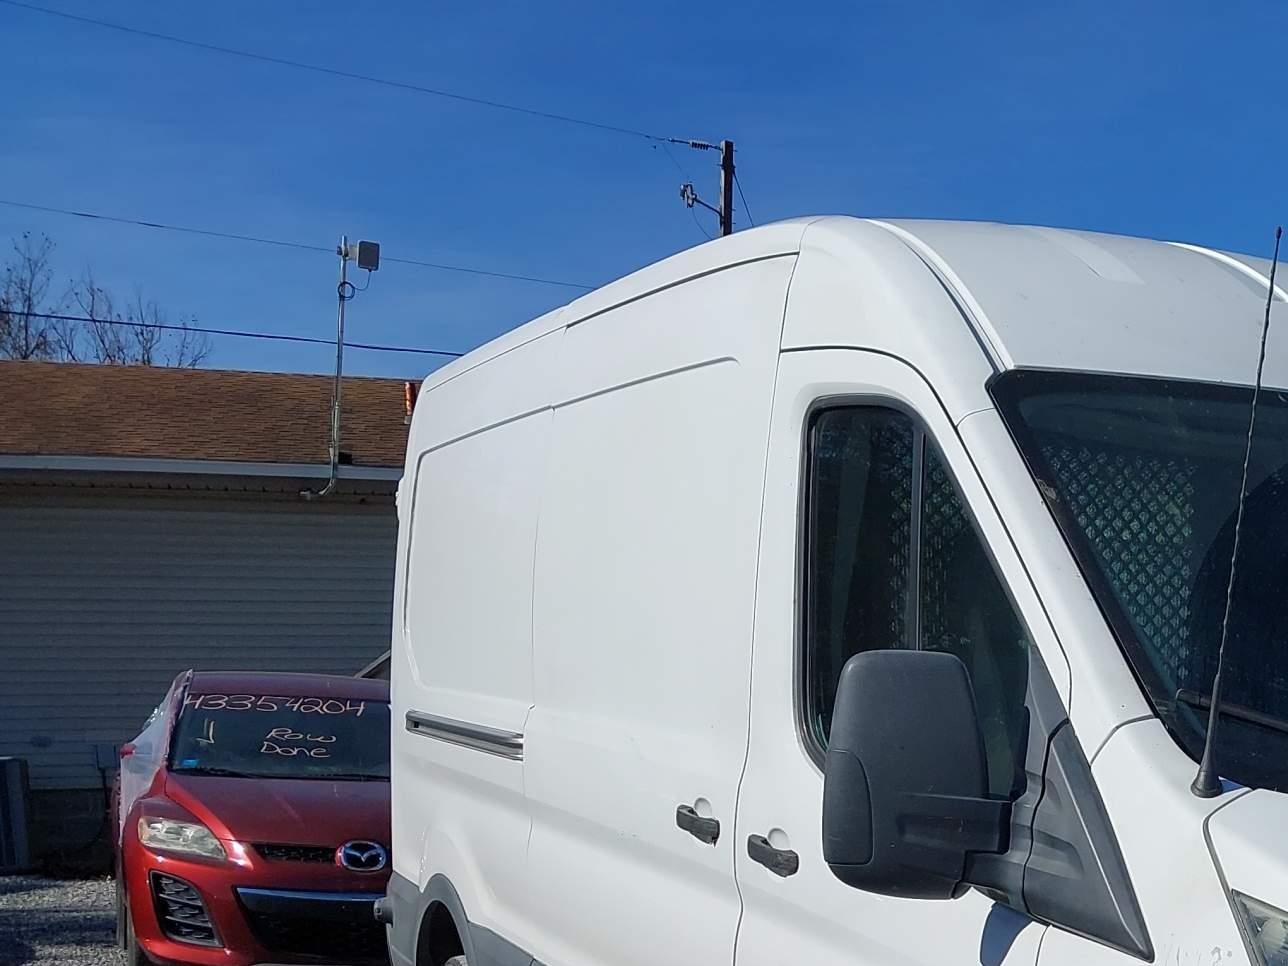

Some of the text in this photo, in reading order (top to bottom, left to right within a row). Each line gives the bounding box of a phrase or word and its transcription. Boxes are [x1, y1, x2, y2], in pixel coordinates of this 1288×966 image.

[184, 694, 365, 717] 43354204
[266, 727, 337, 743] Row
[260, 741, 331, 758] Done
